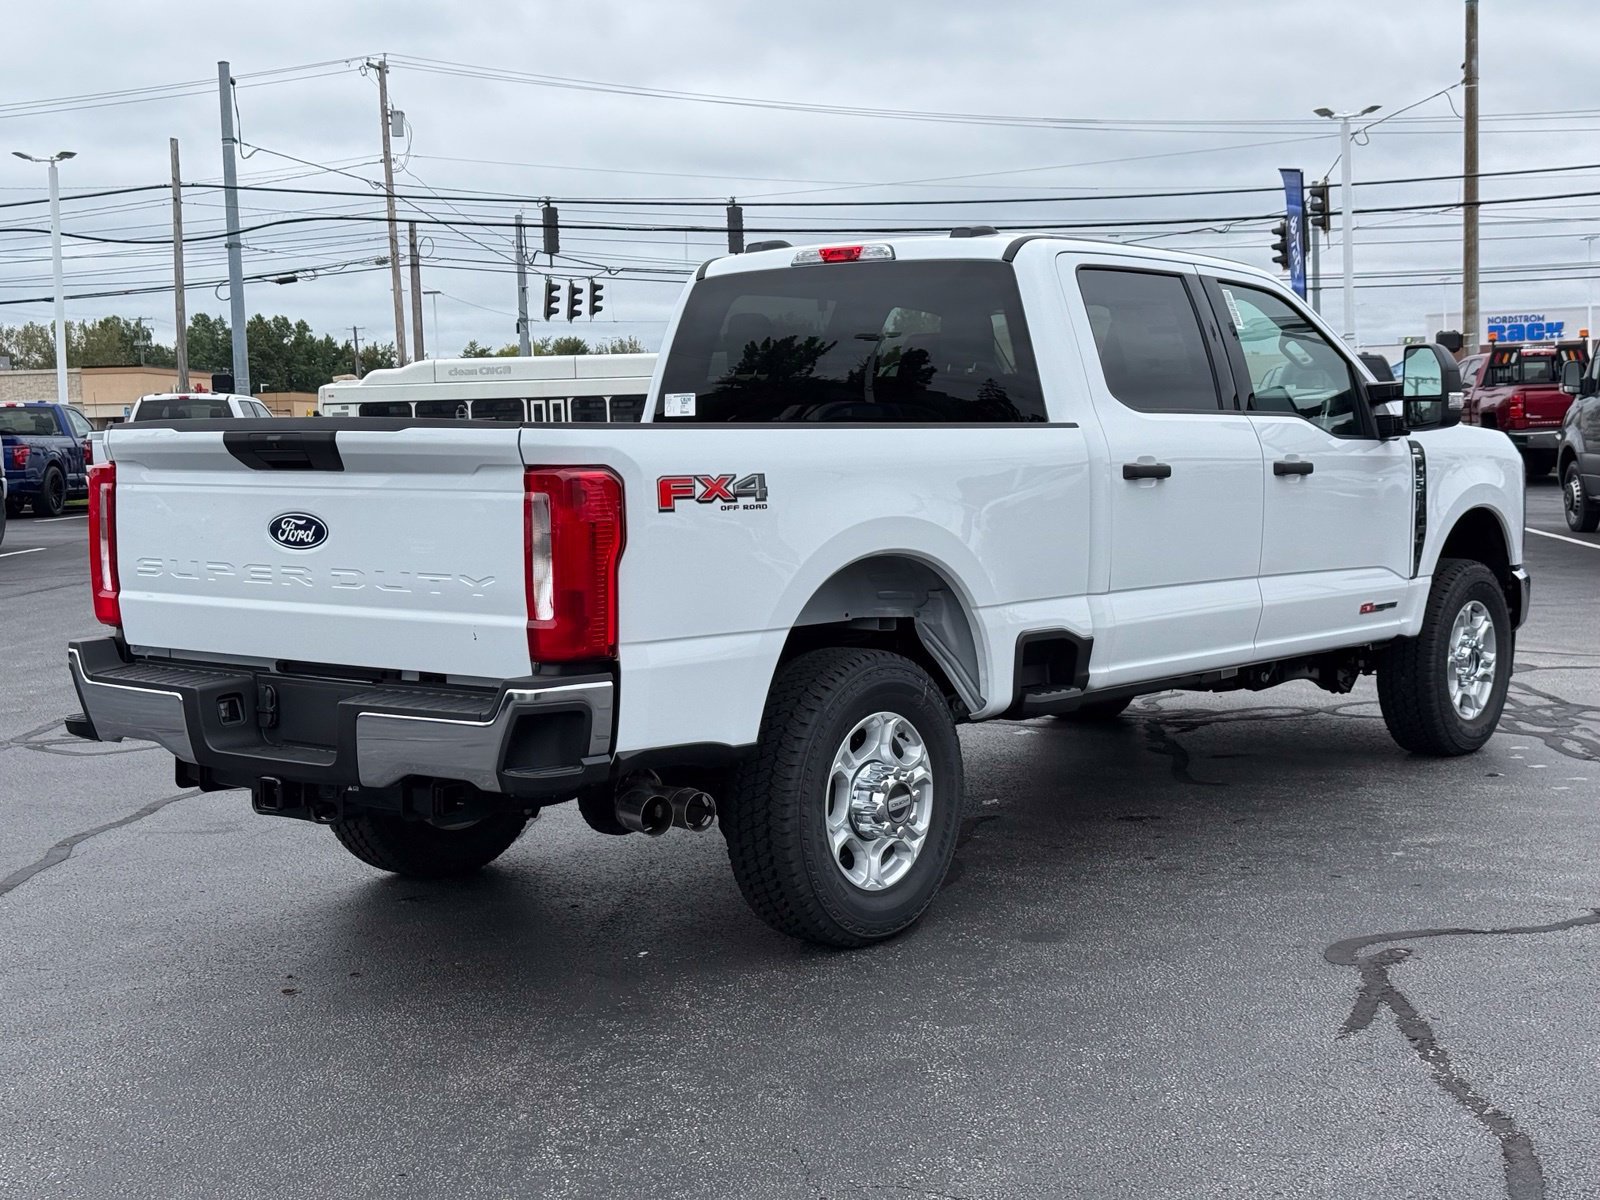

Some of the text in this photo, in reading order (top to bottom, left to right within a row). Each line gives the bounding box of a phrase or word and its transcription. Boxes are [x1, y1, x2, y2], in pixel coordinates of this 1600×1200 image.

[1487, 314, 1545, 324] NORDSTROM
[448, 367, 478, 376] clean
[656, 472, 768, 513] FX4
[277, 517, 315, 543] Ford
[136, 557, 496, 597] SUPER DUTY
